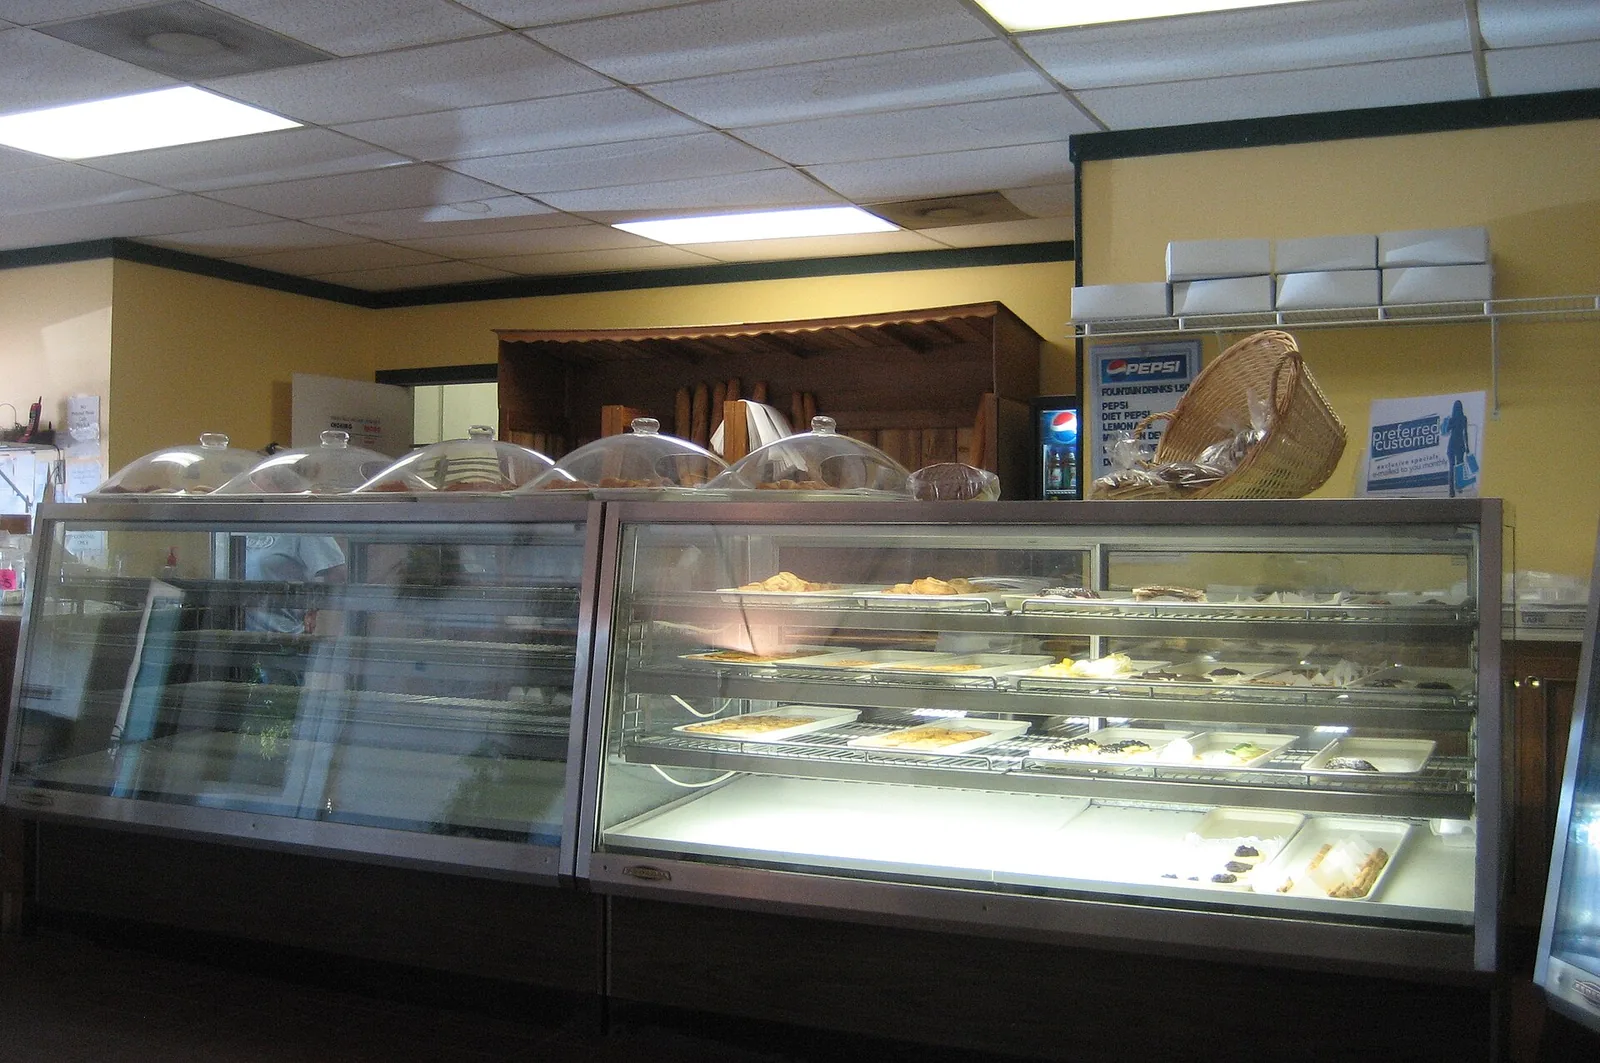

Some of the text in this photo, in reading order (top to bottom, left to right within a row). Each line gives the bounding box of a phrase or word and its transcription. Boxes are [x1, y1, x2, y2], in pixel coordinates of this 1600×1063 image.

[1126, 361, 1180, 375] PEPSI
[1102, 386, 1141, 396] FOUNTAIN
[1142, 384, 1174, 394] DRINKS
[1102, 401, 1129, 411] PEPSI
[1102, 410, 1150, 421] DIET PEPSI
[1373, 418, 1441, 446] preferred
[1375, 433, 1441, 451] customer
[1377, 454, 1439, 470] exclusive specials
